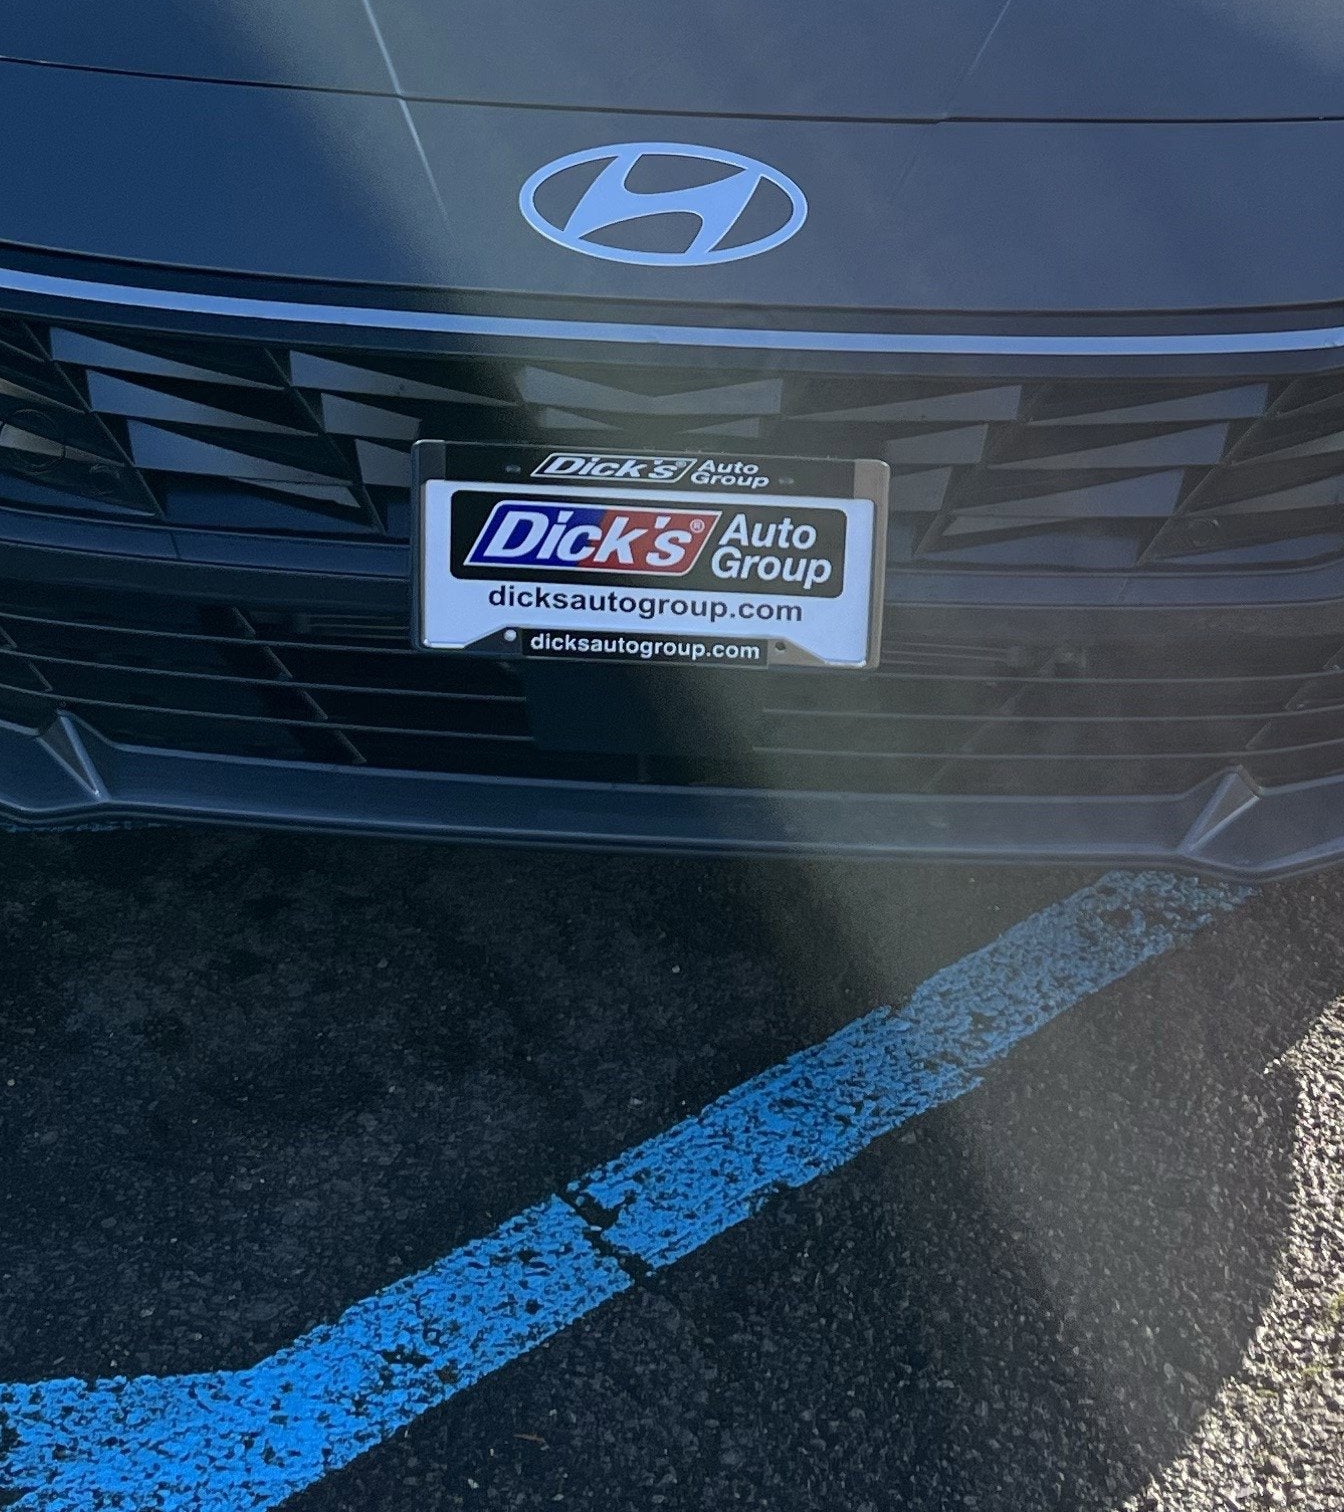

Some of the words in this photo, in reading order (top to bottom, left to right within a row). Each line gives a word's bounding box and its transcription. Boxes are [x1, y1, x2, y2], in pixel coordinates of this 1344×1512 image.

[544, 457, 678, 479] Dick's
[697, 460, 759, 475] Auto
[691, 472, 770, 489] Group
[483, 509, 692, 566] Dick's
[718, 514, 817, 550] Auto
[711, 547, 832, 589] Group
[488, 586, 803, 623] dicksautogroup.com
[530, 633, 760, 662] dicksautogroup.com
